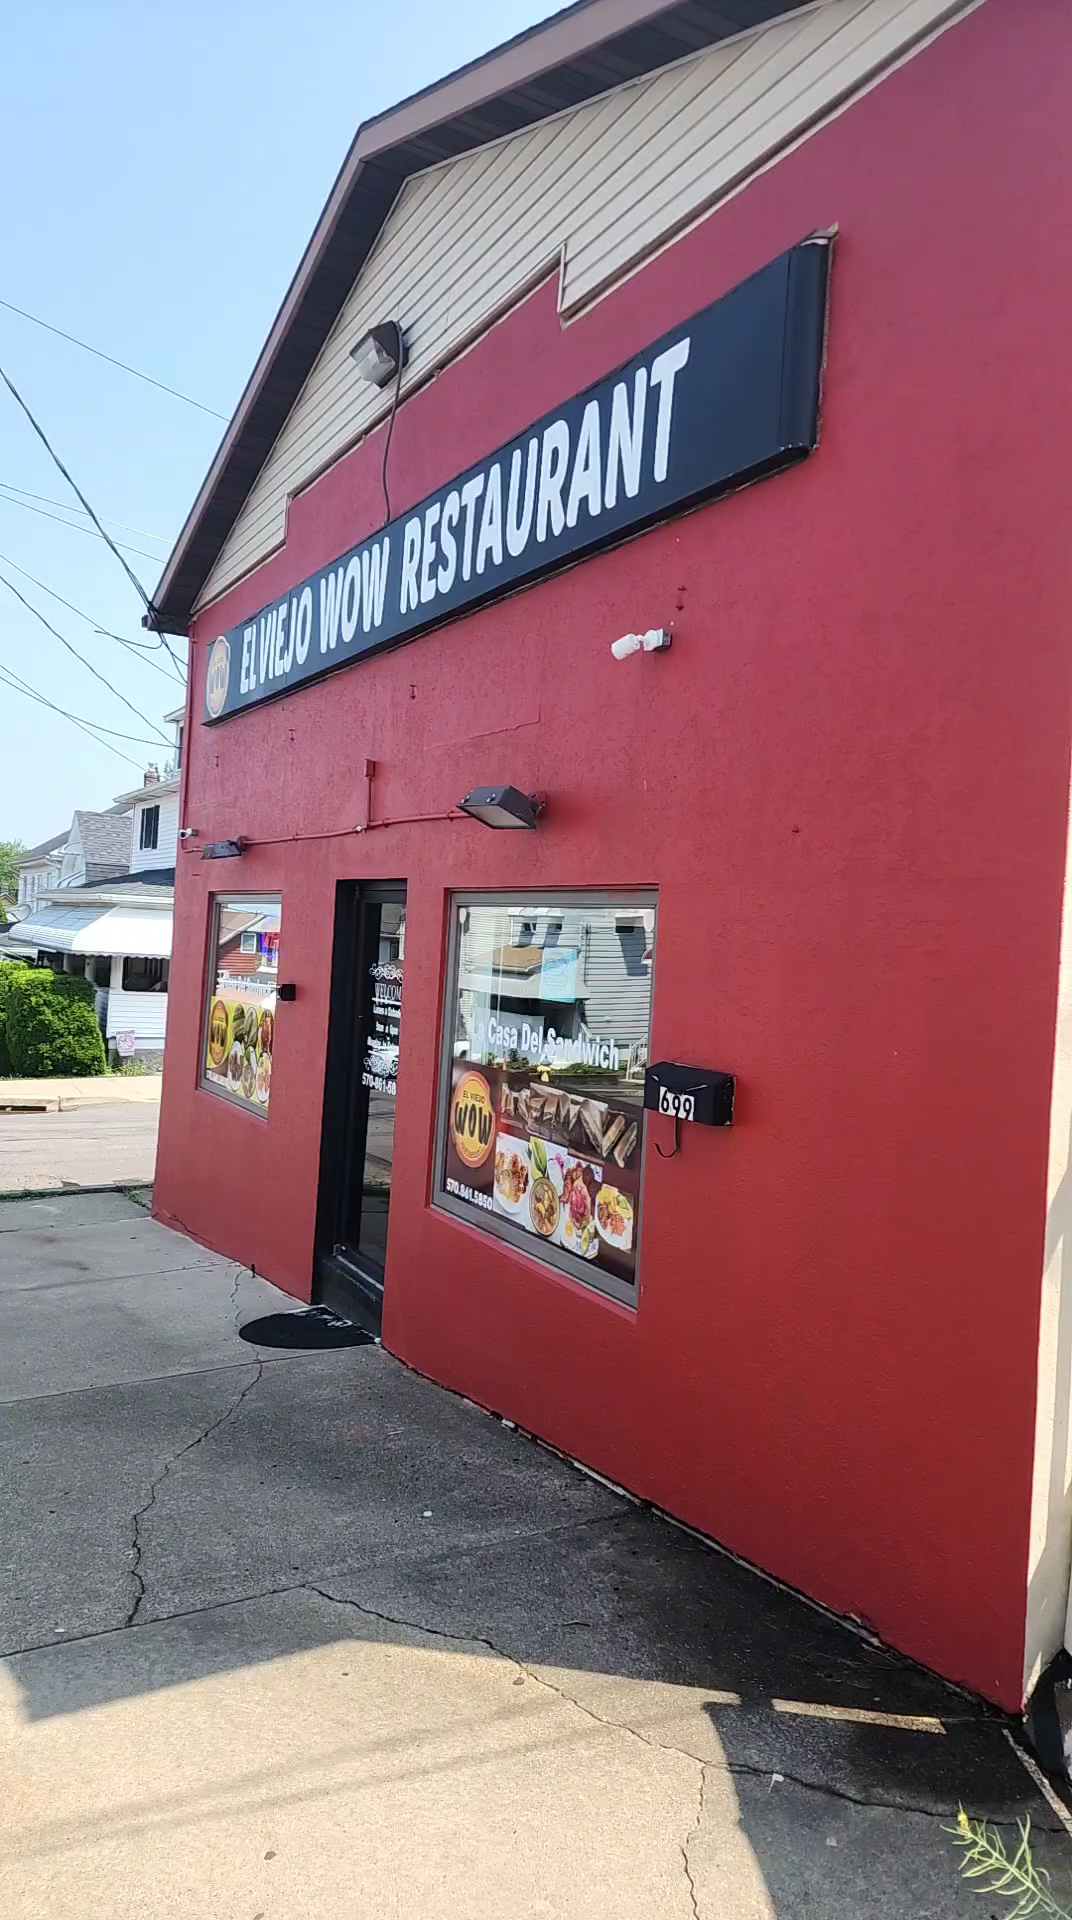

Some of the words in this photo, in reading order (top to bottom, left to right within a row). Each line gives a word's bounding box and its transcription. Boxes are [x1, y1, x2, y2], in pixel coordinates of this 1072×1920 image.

[319, 536, 390, 654] WOW
[400, 337, 691, 614] RESTAURANT
[488, 1017, 517, 1049] Casa
[521, 1023, 543, 1054] Del
[547, 1028, 619, 1071] Sandwich
[454, 1102, 493, 1146] WOW
[661, 1089, 692, 1120] 699
